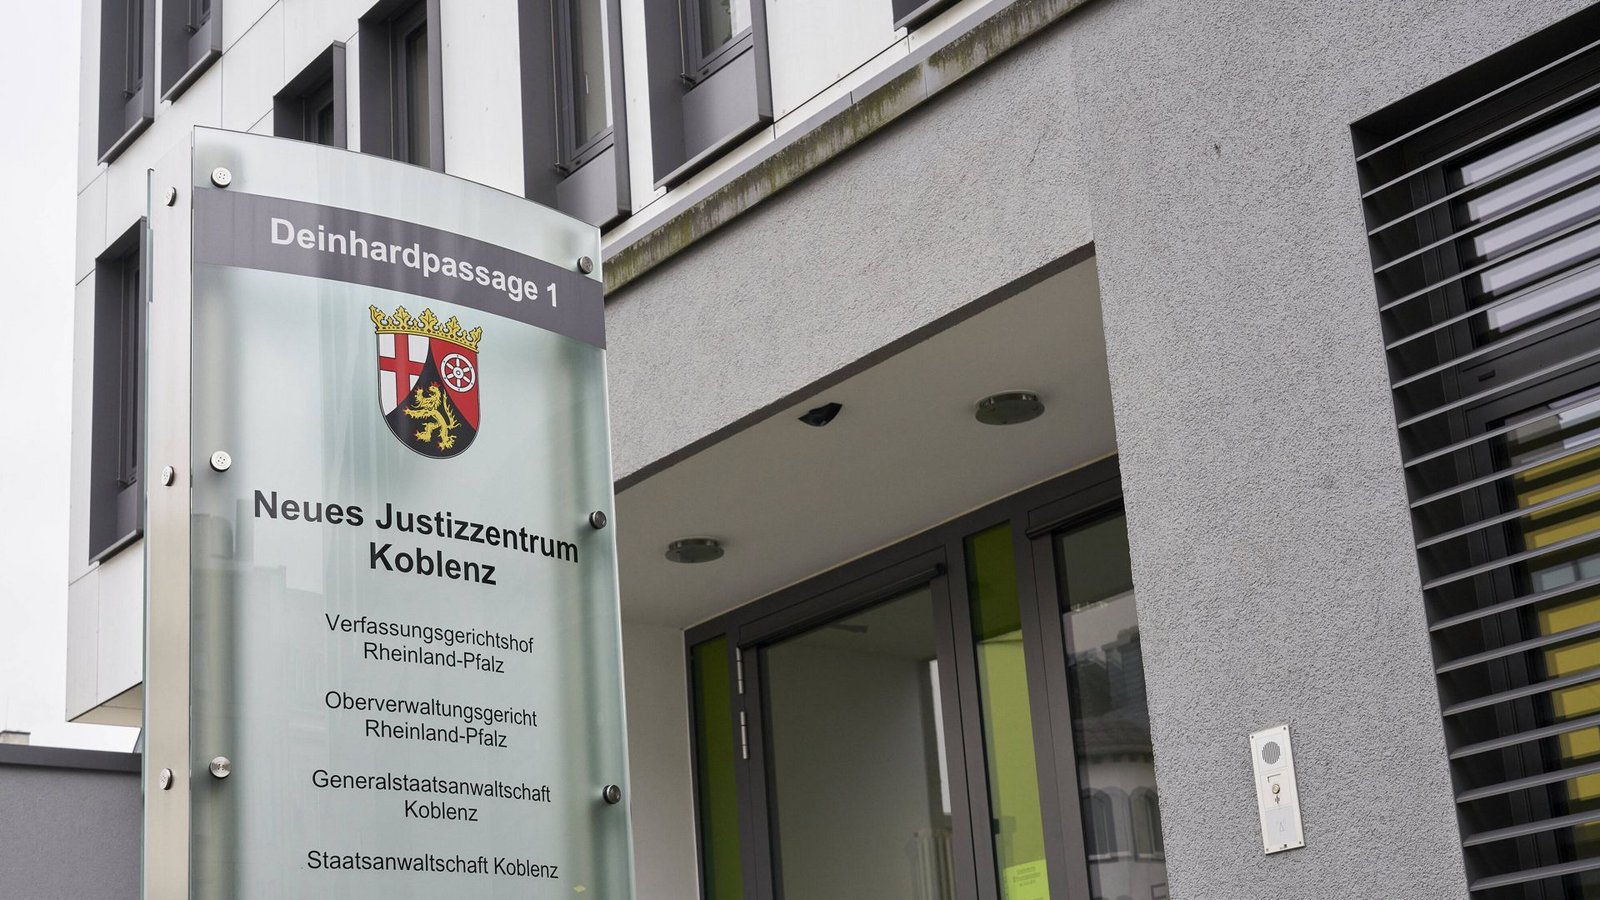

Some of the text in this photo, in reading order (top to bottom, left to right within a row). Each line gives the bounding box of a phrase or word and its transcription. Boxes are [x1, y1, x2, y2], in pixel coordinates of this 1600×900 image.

[270, 217, 558, 307] Deinhardpassage 1
[253, 490, 579, 563] Neues Justizzentrum
[369, 542, 497, 585] Koblenz
[325, 613, 534, 654] Verfassungsgerichtshof
[364, 641, 505, 674] Rheinland-Pfalz
[325, 690, 538, 727] Oberverwaltungsgericht
[365, 719, 507, 748] Rheinland-Pfalz
[312, 769, 551, 803] Generalstaatsanwaltschaft
[404, 799, 478, 822] Koblenz
[307, 850, 559, 879] Staatsanwaltschaft Koblenz
